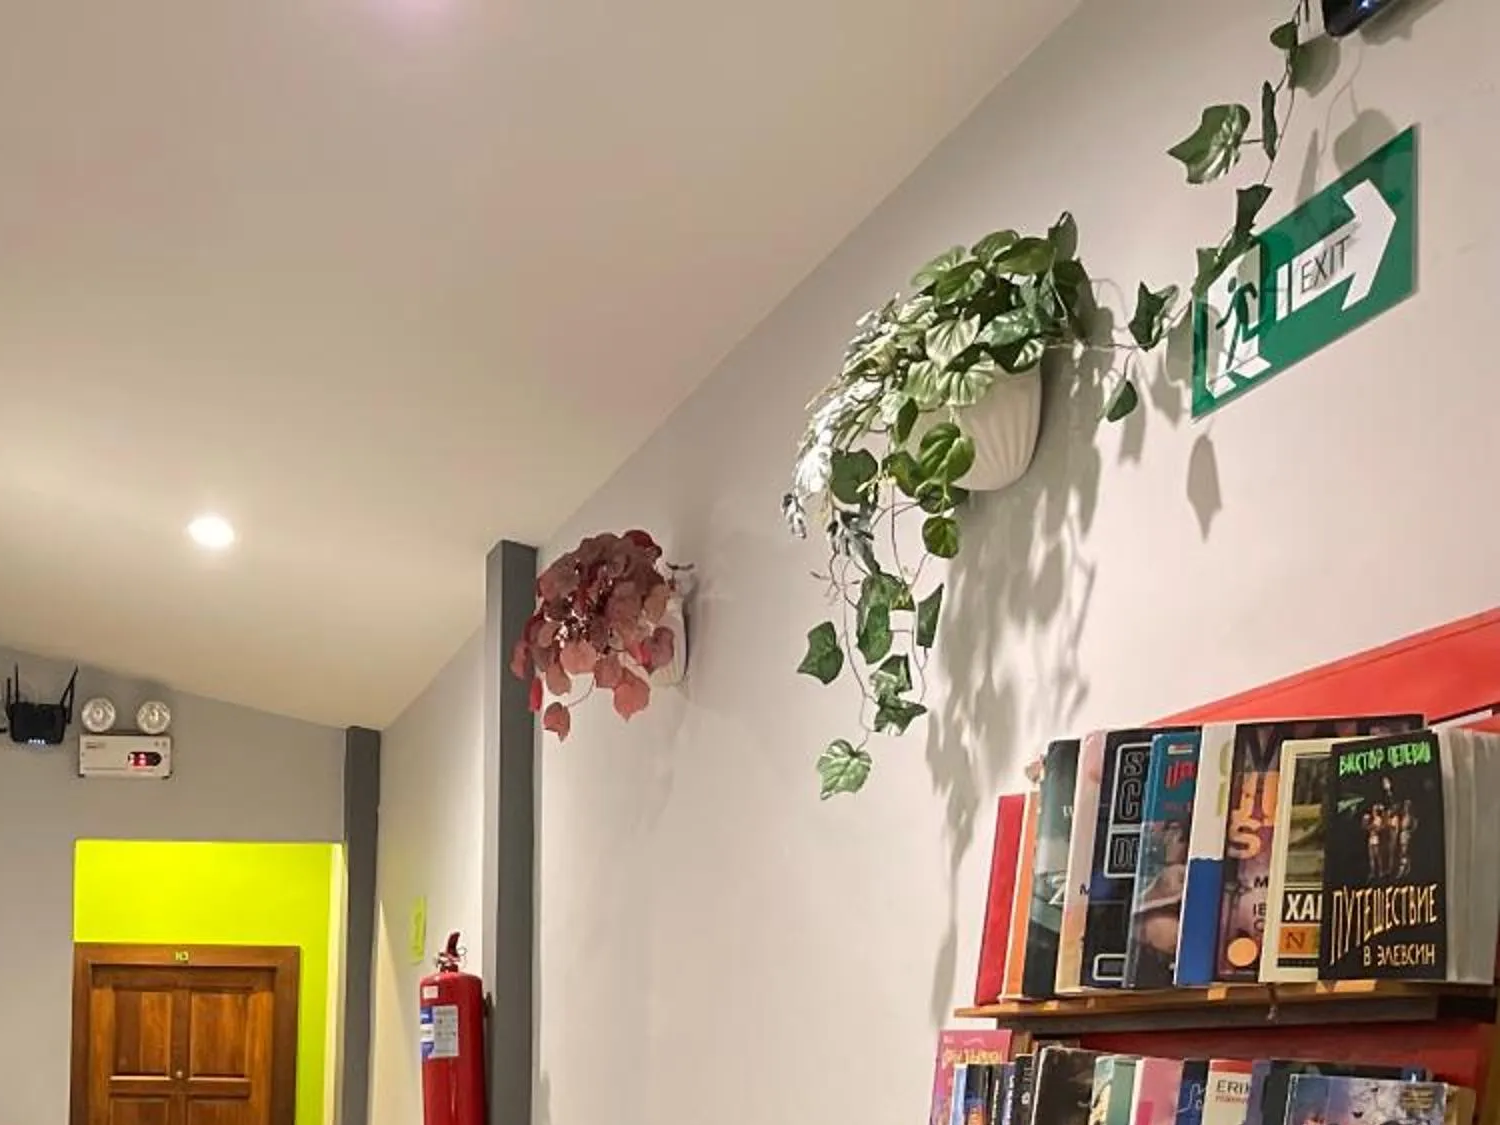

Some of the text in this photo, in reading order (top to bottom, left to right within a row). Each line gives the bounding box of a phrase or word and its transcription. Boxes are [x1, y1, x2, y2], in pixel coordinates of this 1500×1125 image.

[1301, 236, 1351, 293] EXIT
[1330, 883, 1438, 966] ПУТЕШЕСТВИЕ
[1363, 944, 1436, 966] В ЭЛЕВСИН
